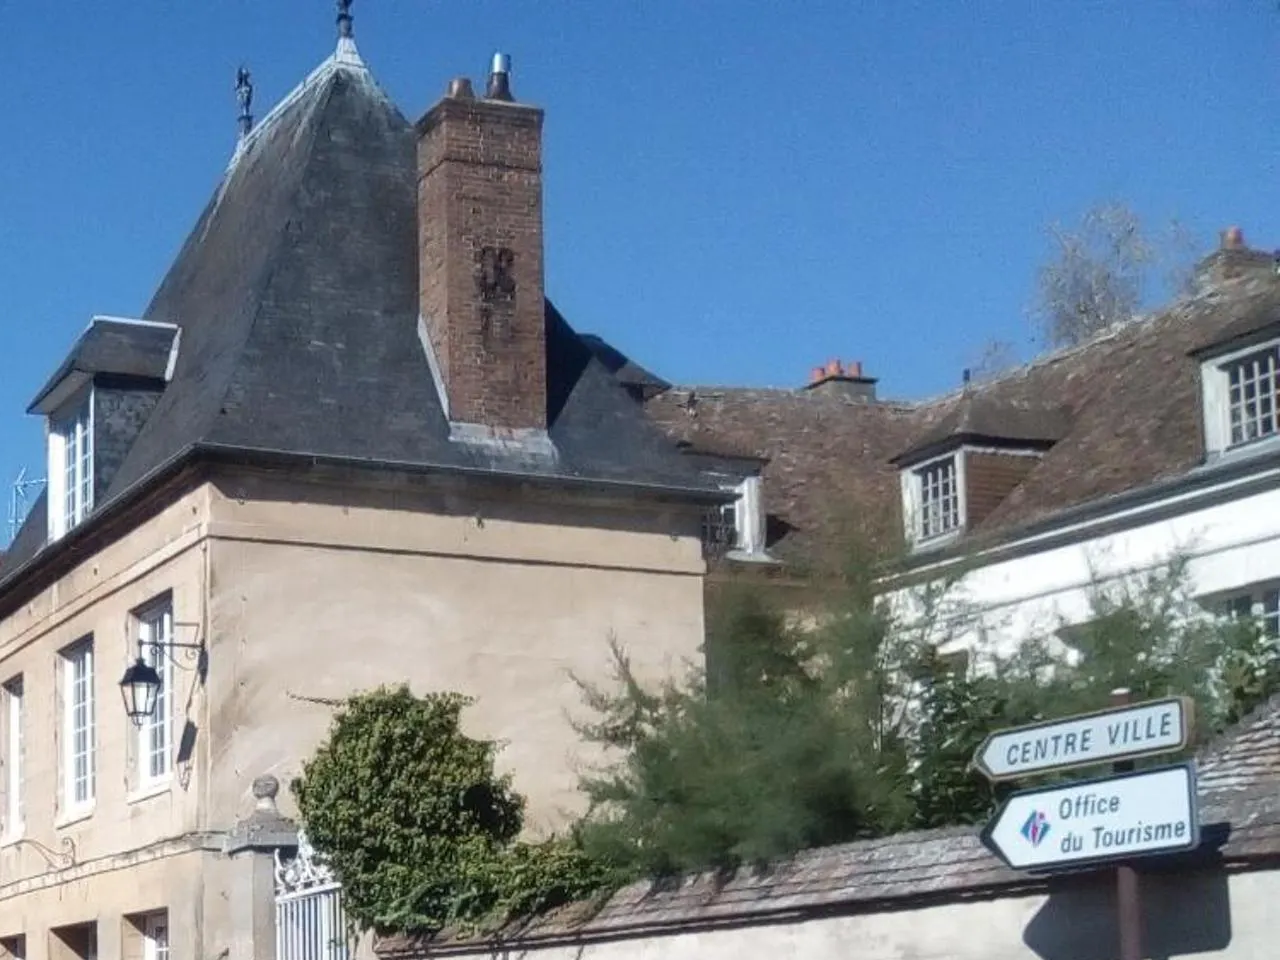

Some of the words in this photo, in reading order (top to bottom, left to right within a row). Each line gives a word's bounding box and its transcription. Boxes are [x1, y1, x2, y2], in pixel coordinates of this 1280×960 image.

[1006, 728, 1093, 766] CENTRE
[1107, 712, 1173, 745] VILLE
[1058, 794, 1120, 820] Office
[1060, 833, 1083, 854] du
[1093, 821, 1186, 850] Tourisme
